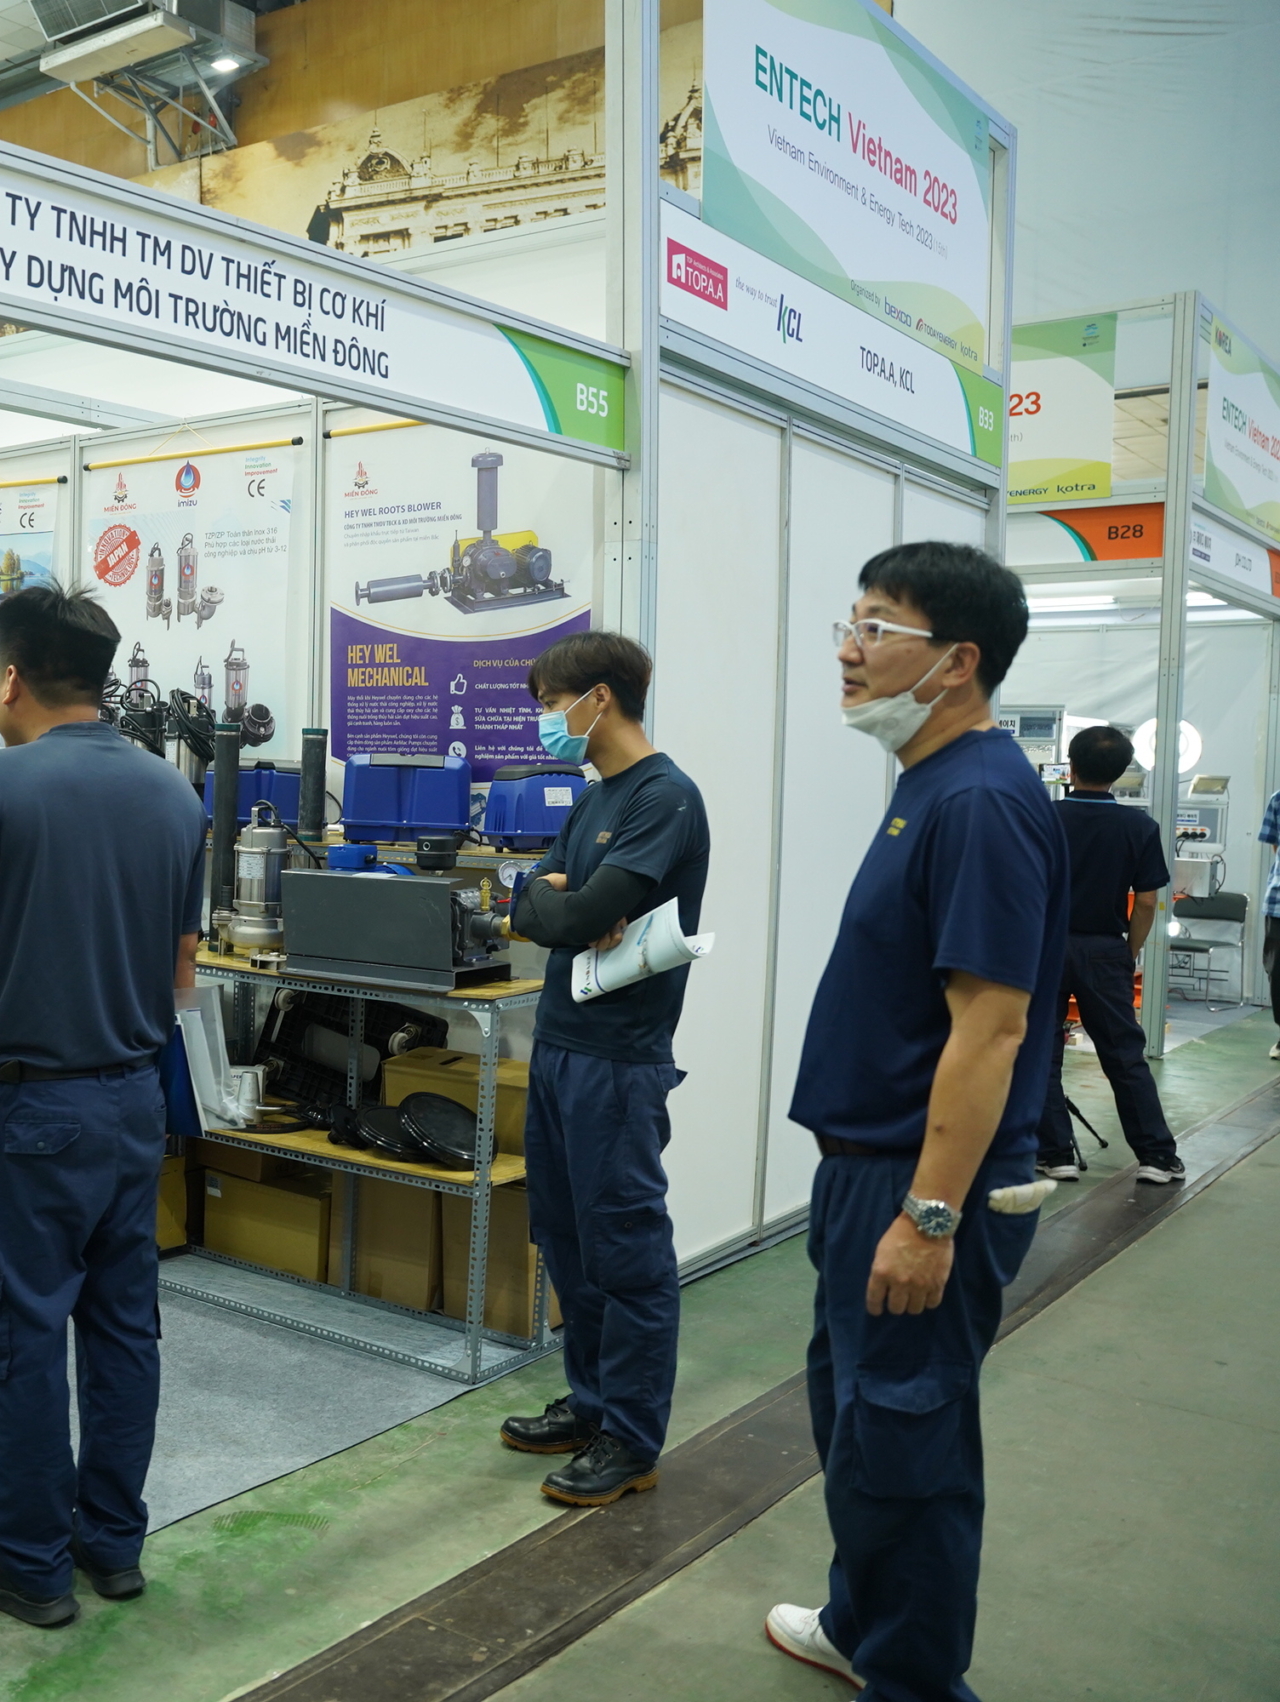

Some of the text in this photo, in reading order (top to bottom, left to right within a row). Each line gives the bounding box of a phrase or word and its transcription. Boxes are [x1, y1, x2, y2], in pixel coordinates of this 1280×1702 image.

[756, 44, 958, 225] ENTECH Vietnam 2023
[768, 124, 805, 166] Vietnam
[808, 151, 859, 202] Environment
[861, 187, 867, 205] &
[870, 192, 896, 227] Energy
[898, 211, 914, 237] Tech
[917, 222, 933, 248] 2023
[6, 192, 42, 231] TY
[51, 205, 127, 257] TNHH
[136, 231, 171, 269] TM
[181, 245, 214, 280] DV
[221, 256, 286, 301] THIẾT
[293, 278, 312, 318] BỊ
[320, 287, 347, 319] CƠ
[352, 299, 386, 332] KHÍ
[686, 267, 724, 302] TOP.A.A
[736, 277, 744, 291] the
[758, 290, 764, 301] to
[765, 293, 777, 308] trust
[851, 280, 881, 308] Organized by
[27, 255, 104, 304] DỰNG
[114, 278, 160, 319] MÔI
[168, 292, 267, 347] TRƯỜNG
[275, 319, 326, 362] MIỀN
[333, 337, 389, 379] ĐÔNG
[885, 296, 911, 327] bexco
[961, 342, 977, 361] kotra
[900, 367, 914, 394] KCL
[979, 406, 993, 431] B33
[1222, 396, 1269, 452] ENTECH Vietnam
[245, 469, 277, 477] Improvement
[1057, 482, 1096, 494] kotra
[178, 499, 198, 507] imizu
[345, 502, 441, 518] HEY WEL ROOTS BLOWER
[1108, 524, 1144, 539] B28
[107, 542, 128, 568] JAPAN
[347, 644, 401, 664] HEY WEL
[474, 658, 519, 669] DỊCH VỤ CỦA
[347, 666, 429, 687] MECHANICAL
